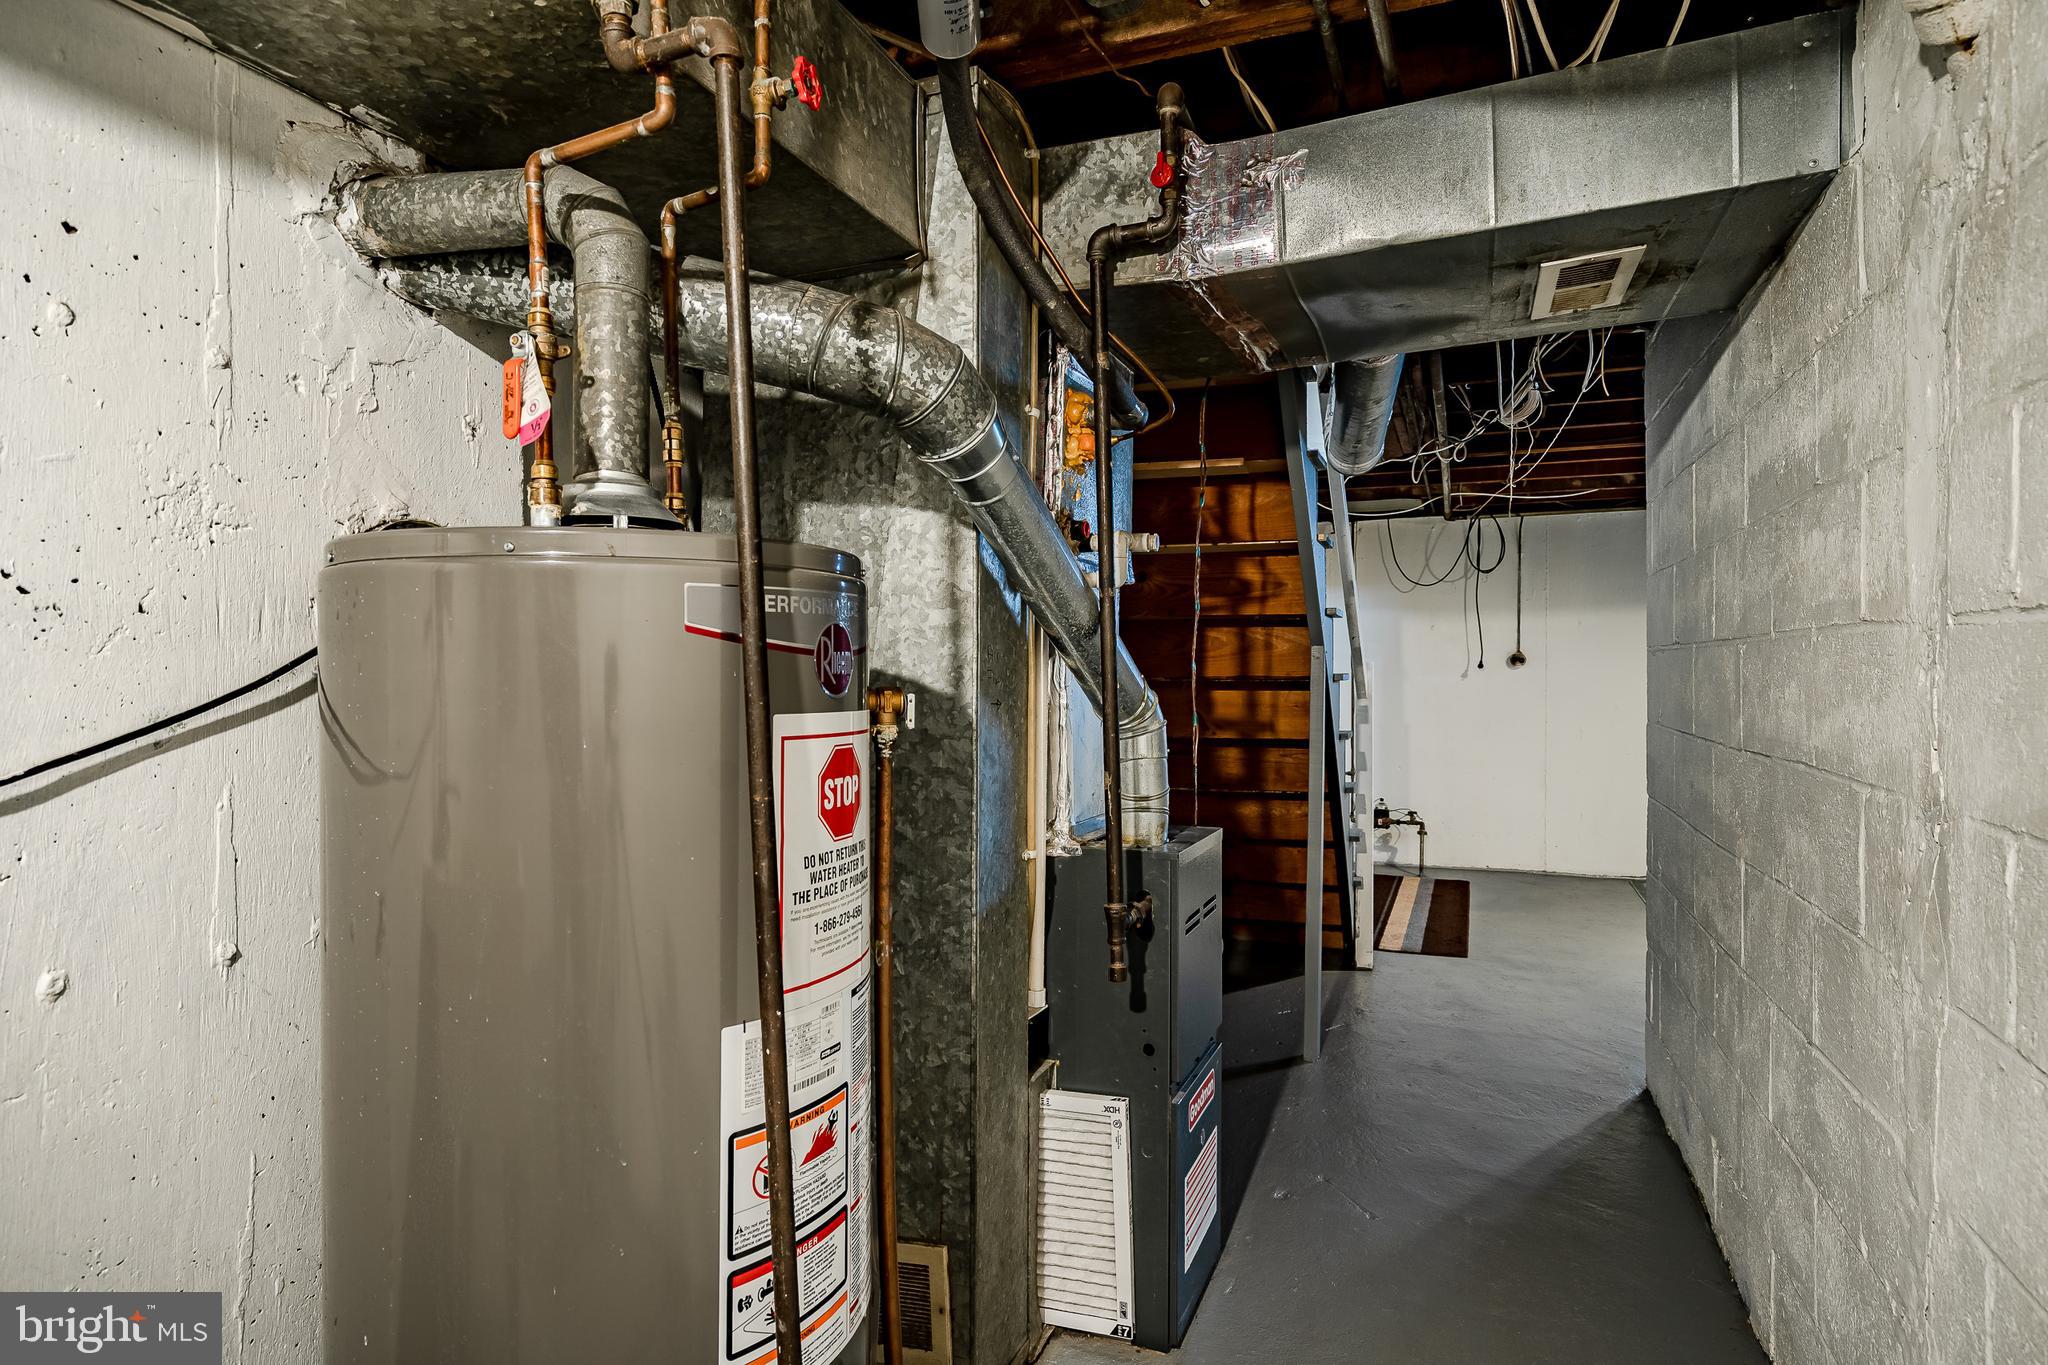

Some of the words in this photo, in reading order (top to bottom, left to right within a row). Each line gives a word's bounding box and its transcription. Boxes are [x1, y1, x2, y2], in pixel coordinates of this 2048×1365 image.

[820, 624, 852, 685] Rheem
[823, 774, 859, 811] STOP
[804, 854, 816, 869] DO
[818, 851, 834, 866] NOT
[835, 844, 858, 862] RETURN
[809, 866, 837, 885] WATER
[838, 858, 860, 877] HEATER
[859, 854, 865, 867] TO
[792, 889, 811, 906] THE
[813, 882, 838, 901] PLACE
[840, 878, 848, 893] OF
[1103, 1105, 1121, 1114] HDX
[1190, 1078, 1215, 1122] Goodman
[790, 1106, 825, 1129] ARNING
[796, 1236, 818, 1256] NGER
[1122, 1326, 1130, 1337] 7
